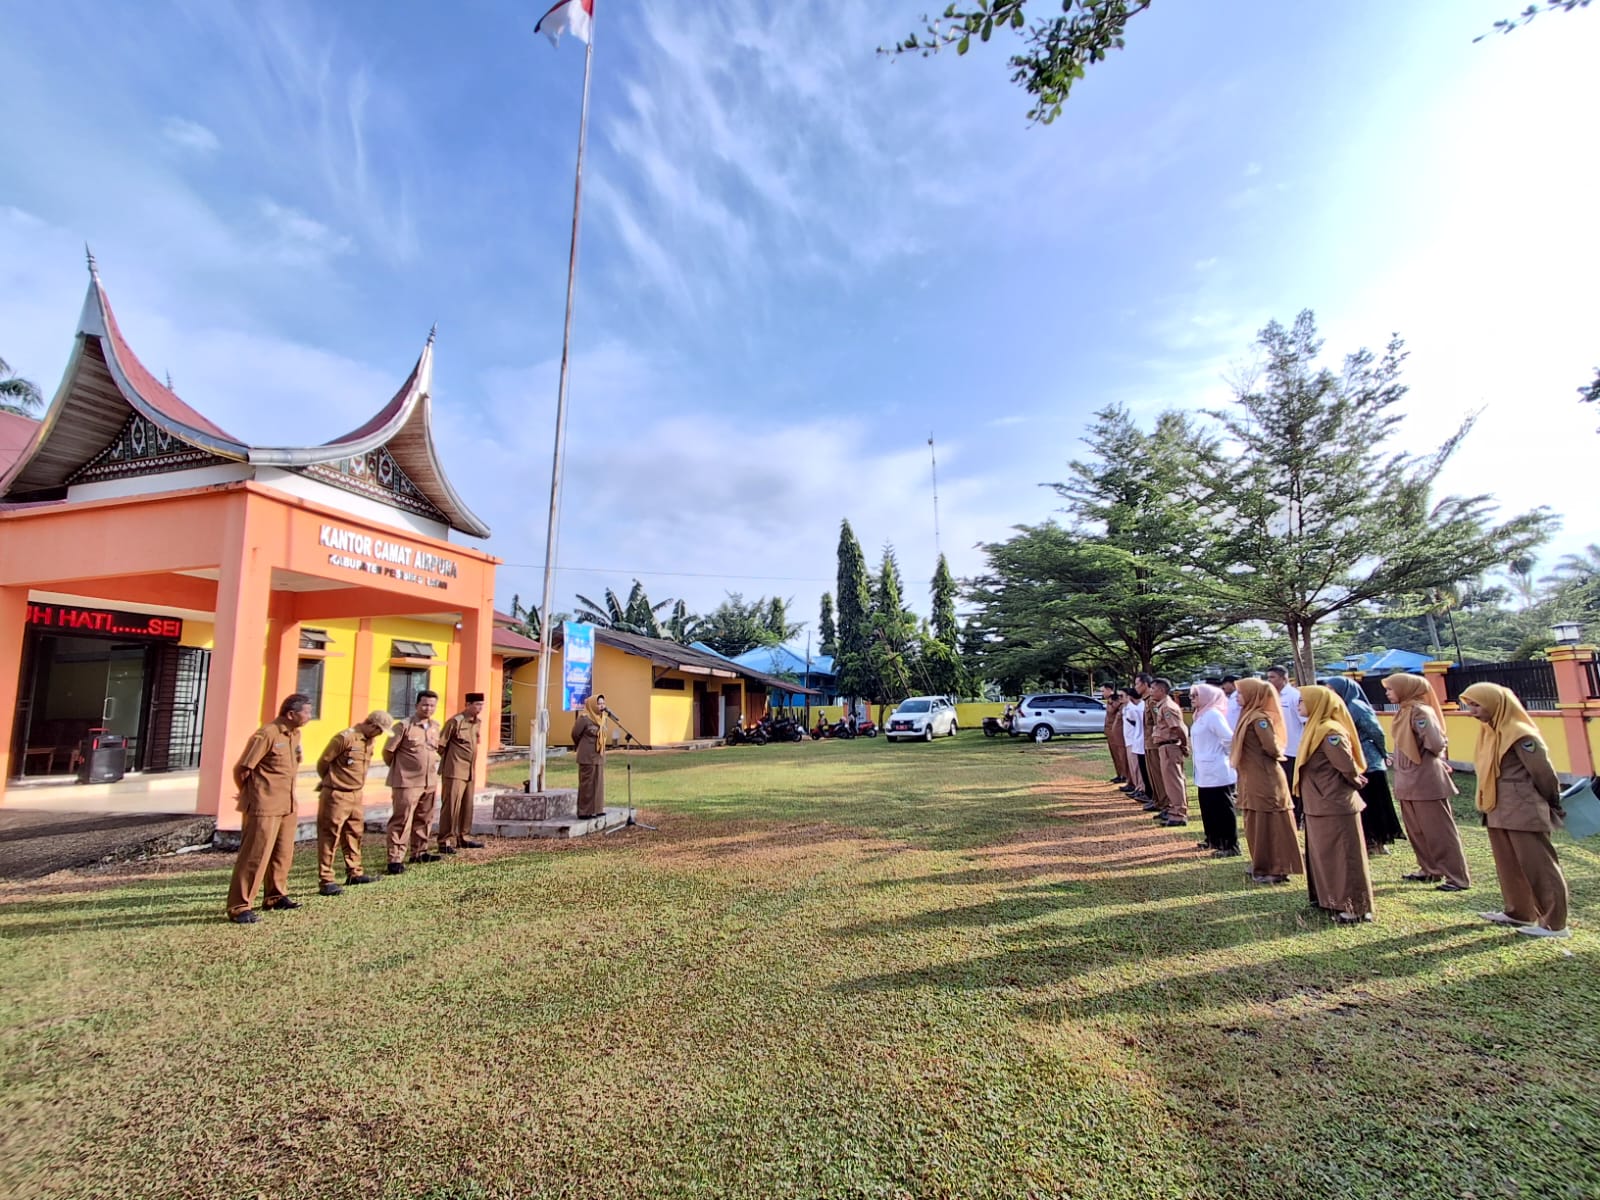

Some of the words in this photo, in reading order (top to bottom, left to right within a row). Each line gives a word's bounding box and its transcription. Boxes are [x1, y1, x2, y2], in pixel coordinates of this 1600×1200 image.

[319, 525, 371, 557] KANTOR
[374, 539, 412, 566] CAMAT
[328, 553, 382, 575] KABUPATEN
